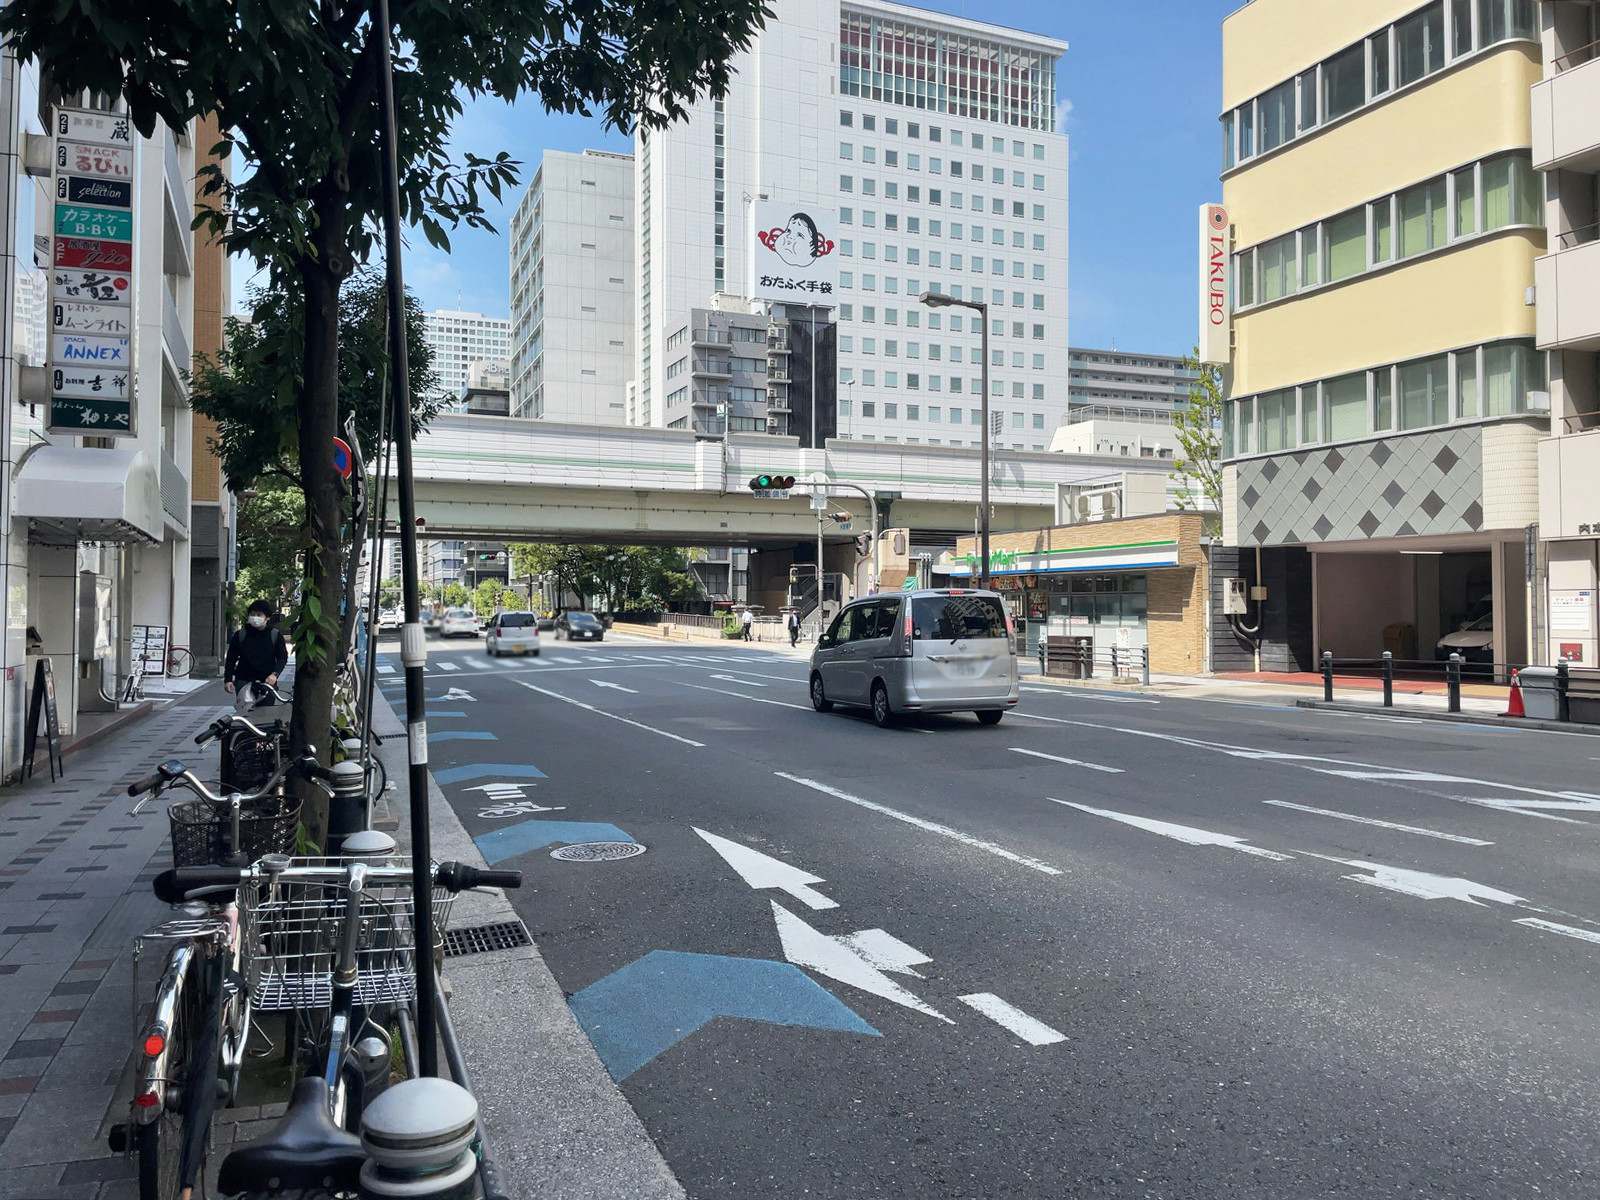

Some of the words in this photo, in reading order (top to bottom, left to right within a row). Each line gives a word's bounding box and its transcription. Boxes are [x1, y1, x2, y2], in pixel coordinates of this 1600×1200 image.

[60, 115, 67, 132] 2F
[59, 148, 66, 165] 2F
[75, 145, 120, 158] SNACK
[59, 180, 66, 197] 2F
[56, 242, 65, 260] 2F
[760, 275, 832, 294] おたふく手袋
[1210, 233, 1224, 325] TAKUBO
[68, 304, 102, 312] レストラン
[65, 317, 126, 331] ムーンライト
[64, 344, 121, 360] ANNEX
[966, 549, 1016, 570] FamyMart
